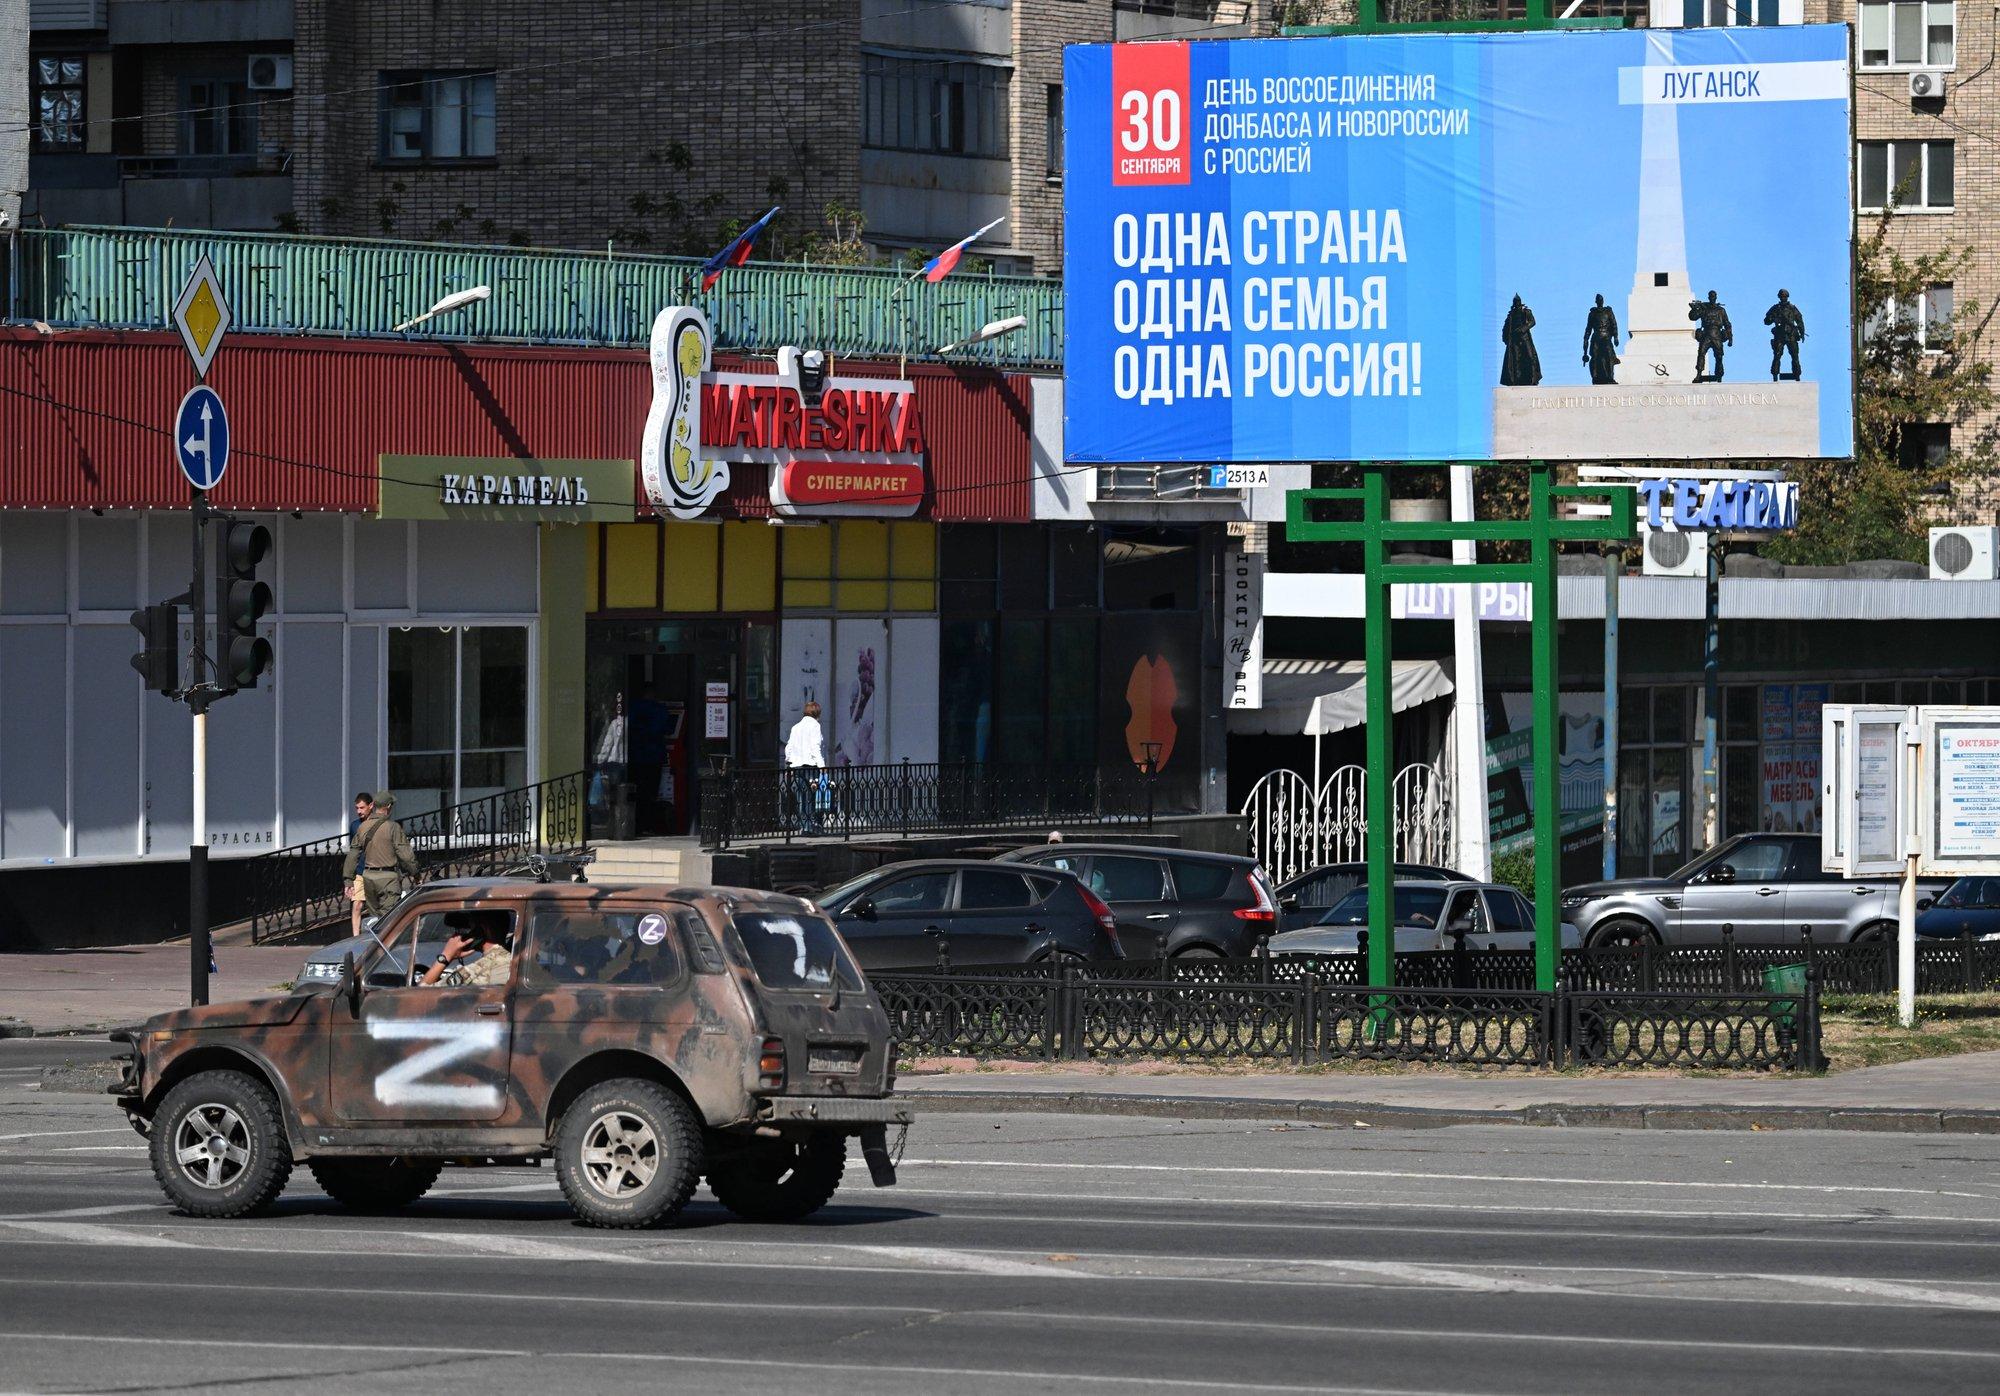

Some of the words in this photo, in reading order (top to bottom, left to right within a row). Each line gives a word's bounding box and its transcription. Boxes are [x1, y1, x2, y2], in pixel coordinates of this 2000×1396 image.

[1204, 79, 1257, 108] ДЕНЬ
[1263, 74, 1435, 106] ВОССОЕДИНЕНИЯ
[1661, 69, 1761, 98] ЛУГАНСК
[1121, 89, 1181, 152] 30
[1204, 111, 1312, 143] ДОНБАССА
[1318, 113, 1331, 138] И
[1337, 109, 1469, 138] НОВОРОССИИ
[1121, 158, 1181, 175] СЕНТЯБРЯ
[1204, 148, 1216, 175] С
[1223, 141, 1311, 174] РОССИЕЙ
[1114, 212, 1231, 273] ОДНА
[1243, 209, 1407, 265] СТРАНА
[1114, 278, 1232, 339] ОДНА
[1243, 275, 1387, 331] СЕМЬЯ
[1114, 344, 1232, 405] ОДНА
[1244, 342, 1422, 397] РОССИЯ!
[701, 383, 923, 454] MATRESHKA
[442, 473, 590, 506] КАРАМЕЛЬ
[806, 473, 908, 492] СУПЕРМАРКЕТ
[1227, 470, 1256, 483] 2513
[1236, 554, 1249, 628] HOOKAH
[1408, 583, 1526, 617] ШТРЫ
[1235, 671, 1247, 705] BAR
[205, 831, 273, 845] РУАСАН
[366, 1013, 506, 1110] Z
